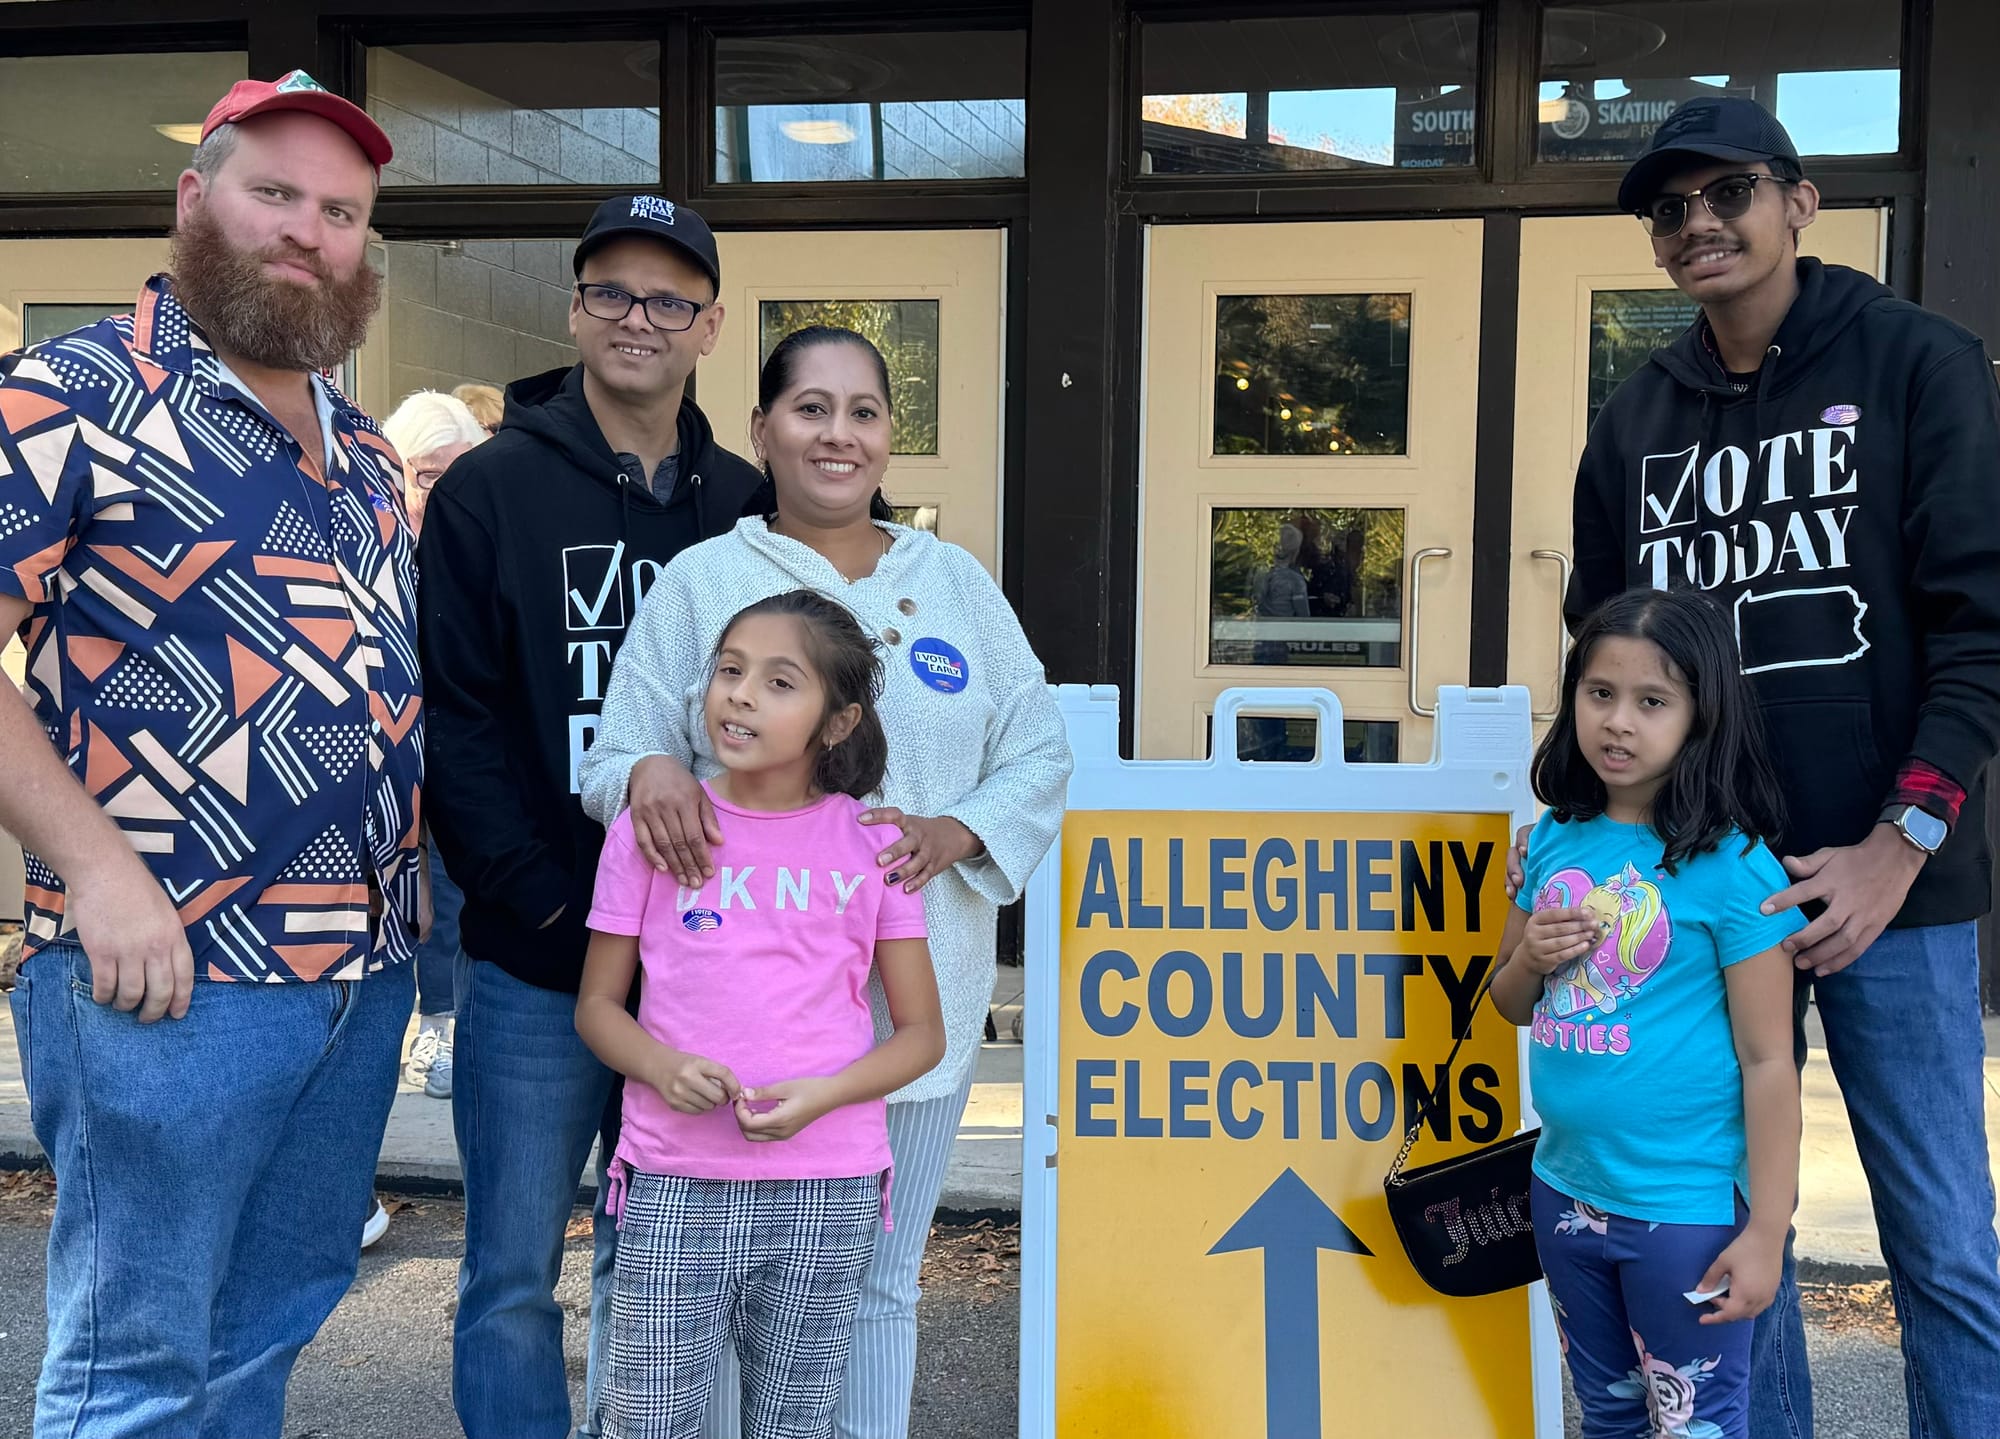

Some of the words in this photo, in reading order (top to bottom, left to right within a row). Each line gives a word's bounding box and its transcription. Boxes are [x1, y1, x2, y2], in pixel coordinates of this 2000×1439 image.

[1597, 101, 1676, 124] SKATING
[630, 208, 647, 217] PA
[1639, 506, 1859, 592] TODAY
[1287, 641, 1360, 652] RULES
[1076, 838, 1494, 932] ALLEGHENY
[1080, 950, 1493, 1040] COUNTY
[1076, 1059, 1503, 1142] ELECTIONS
